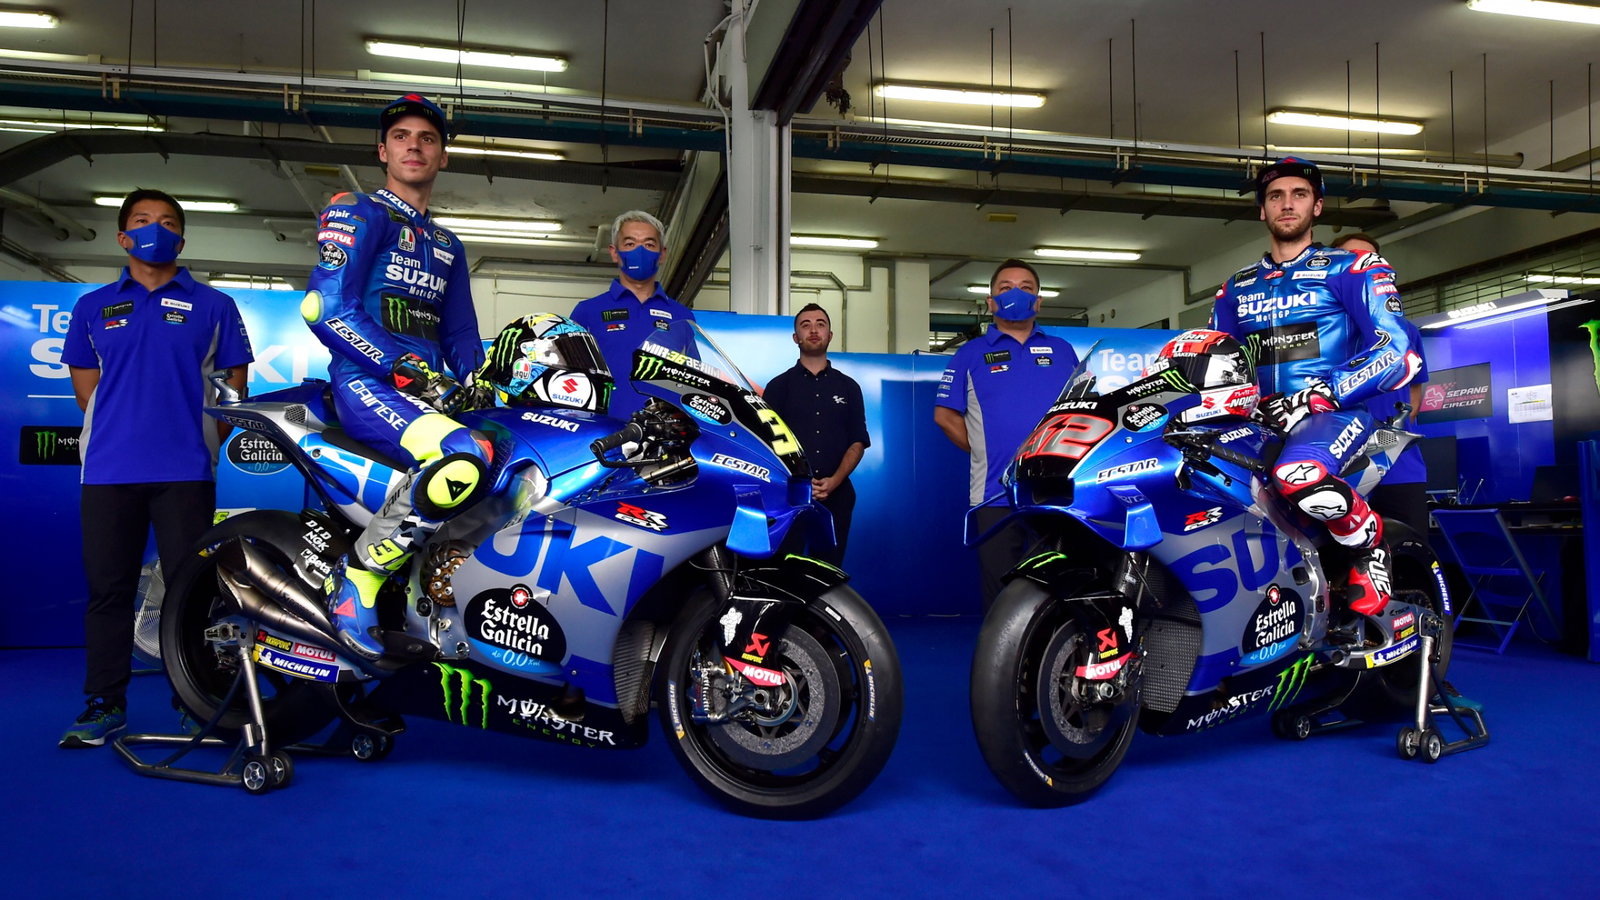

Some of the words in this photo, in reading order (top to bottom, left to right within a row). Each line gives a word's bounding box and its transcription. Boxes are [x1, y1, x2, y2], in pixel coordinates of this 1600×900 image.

[376, 189, 417, 218] SUZUKI
[317, 231, 353, 246] MOTUL
[390, 251, 421, 269] Team
[385, 264, 447, 295] SUZUK
[1376, 284, 1397, 296] MOTU
[1236, 292, 1266, 304] Team
[1237, 291, 1318, 318] SUZUKI
[32, 304, 73, 334] Te
[325, 318, 384, 365] ECSTAR
[1262, 331, 1317, 347] MONSTER
[1268, 341, 1309, 350] NERGY
[661, 365, 711, 387] MONSTER
[1339, 352, 1399, 396] ECSTAR
[1126, 378, 1167, 396] MONSTER
[1446, 385, 1489, 398] SEPANG
[347, 379, 409, 431] DAINESE
[552, 393, 584, 405] SUZUKI
[691, 395, 726, 416] Estrella
[1047, 400, 1098, 414] SUZUKI
[1442, 398, 1485, 409] CIRCUIT
[689, 400, 721, 421] Galicia
[1126, 405, 1156, 423] Estrella
[1133, 410, 1162, 427] Galicia
[1195, 409, 1222, 419] SUZUKI
[521, 411, 580, 433] SUZUKI
[1219, 426, 1254, 443] SUZUKI
[240, 449, 283, 461] Galicia
[711, 453, 770, 482] ECSTAR
[1097, 458, 1160, 484] ECSTAR
[306, 531, 330, 552] NGK
[308, 554, 332, 575] Beta
[1436, 573, 1451, 612] MICHELIN
[481, 598, 549, 640] Estrella
[1255, 600, 1297, 633] Estrella
[1393, 614, 1414, 629] MOTUL
[480, 619, 543, 656] Galicia
[1255, 619, 1295, 648] Galicia
[295, 644, 335, 660] MOTUL
[1385, 639, 1418, 660] MICHELIN
[272, 656, 331, 678] MICHELIN
[742, 665, 782, 686] MOTUL
[1086, 660, 1121, 679] MOTUL
[1186, 684, 1274, 730] MONSTER
[497, 694, 617, 746] MONSTER
